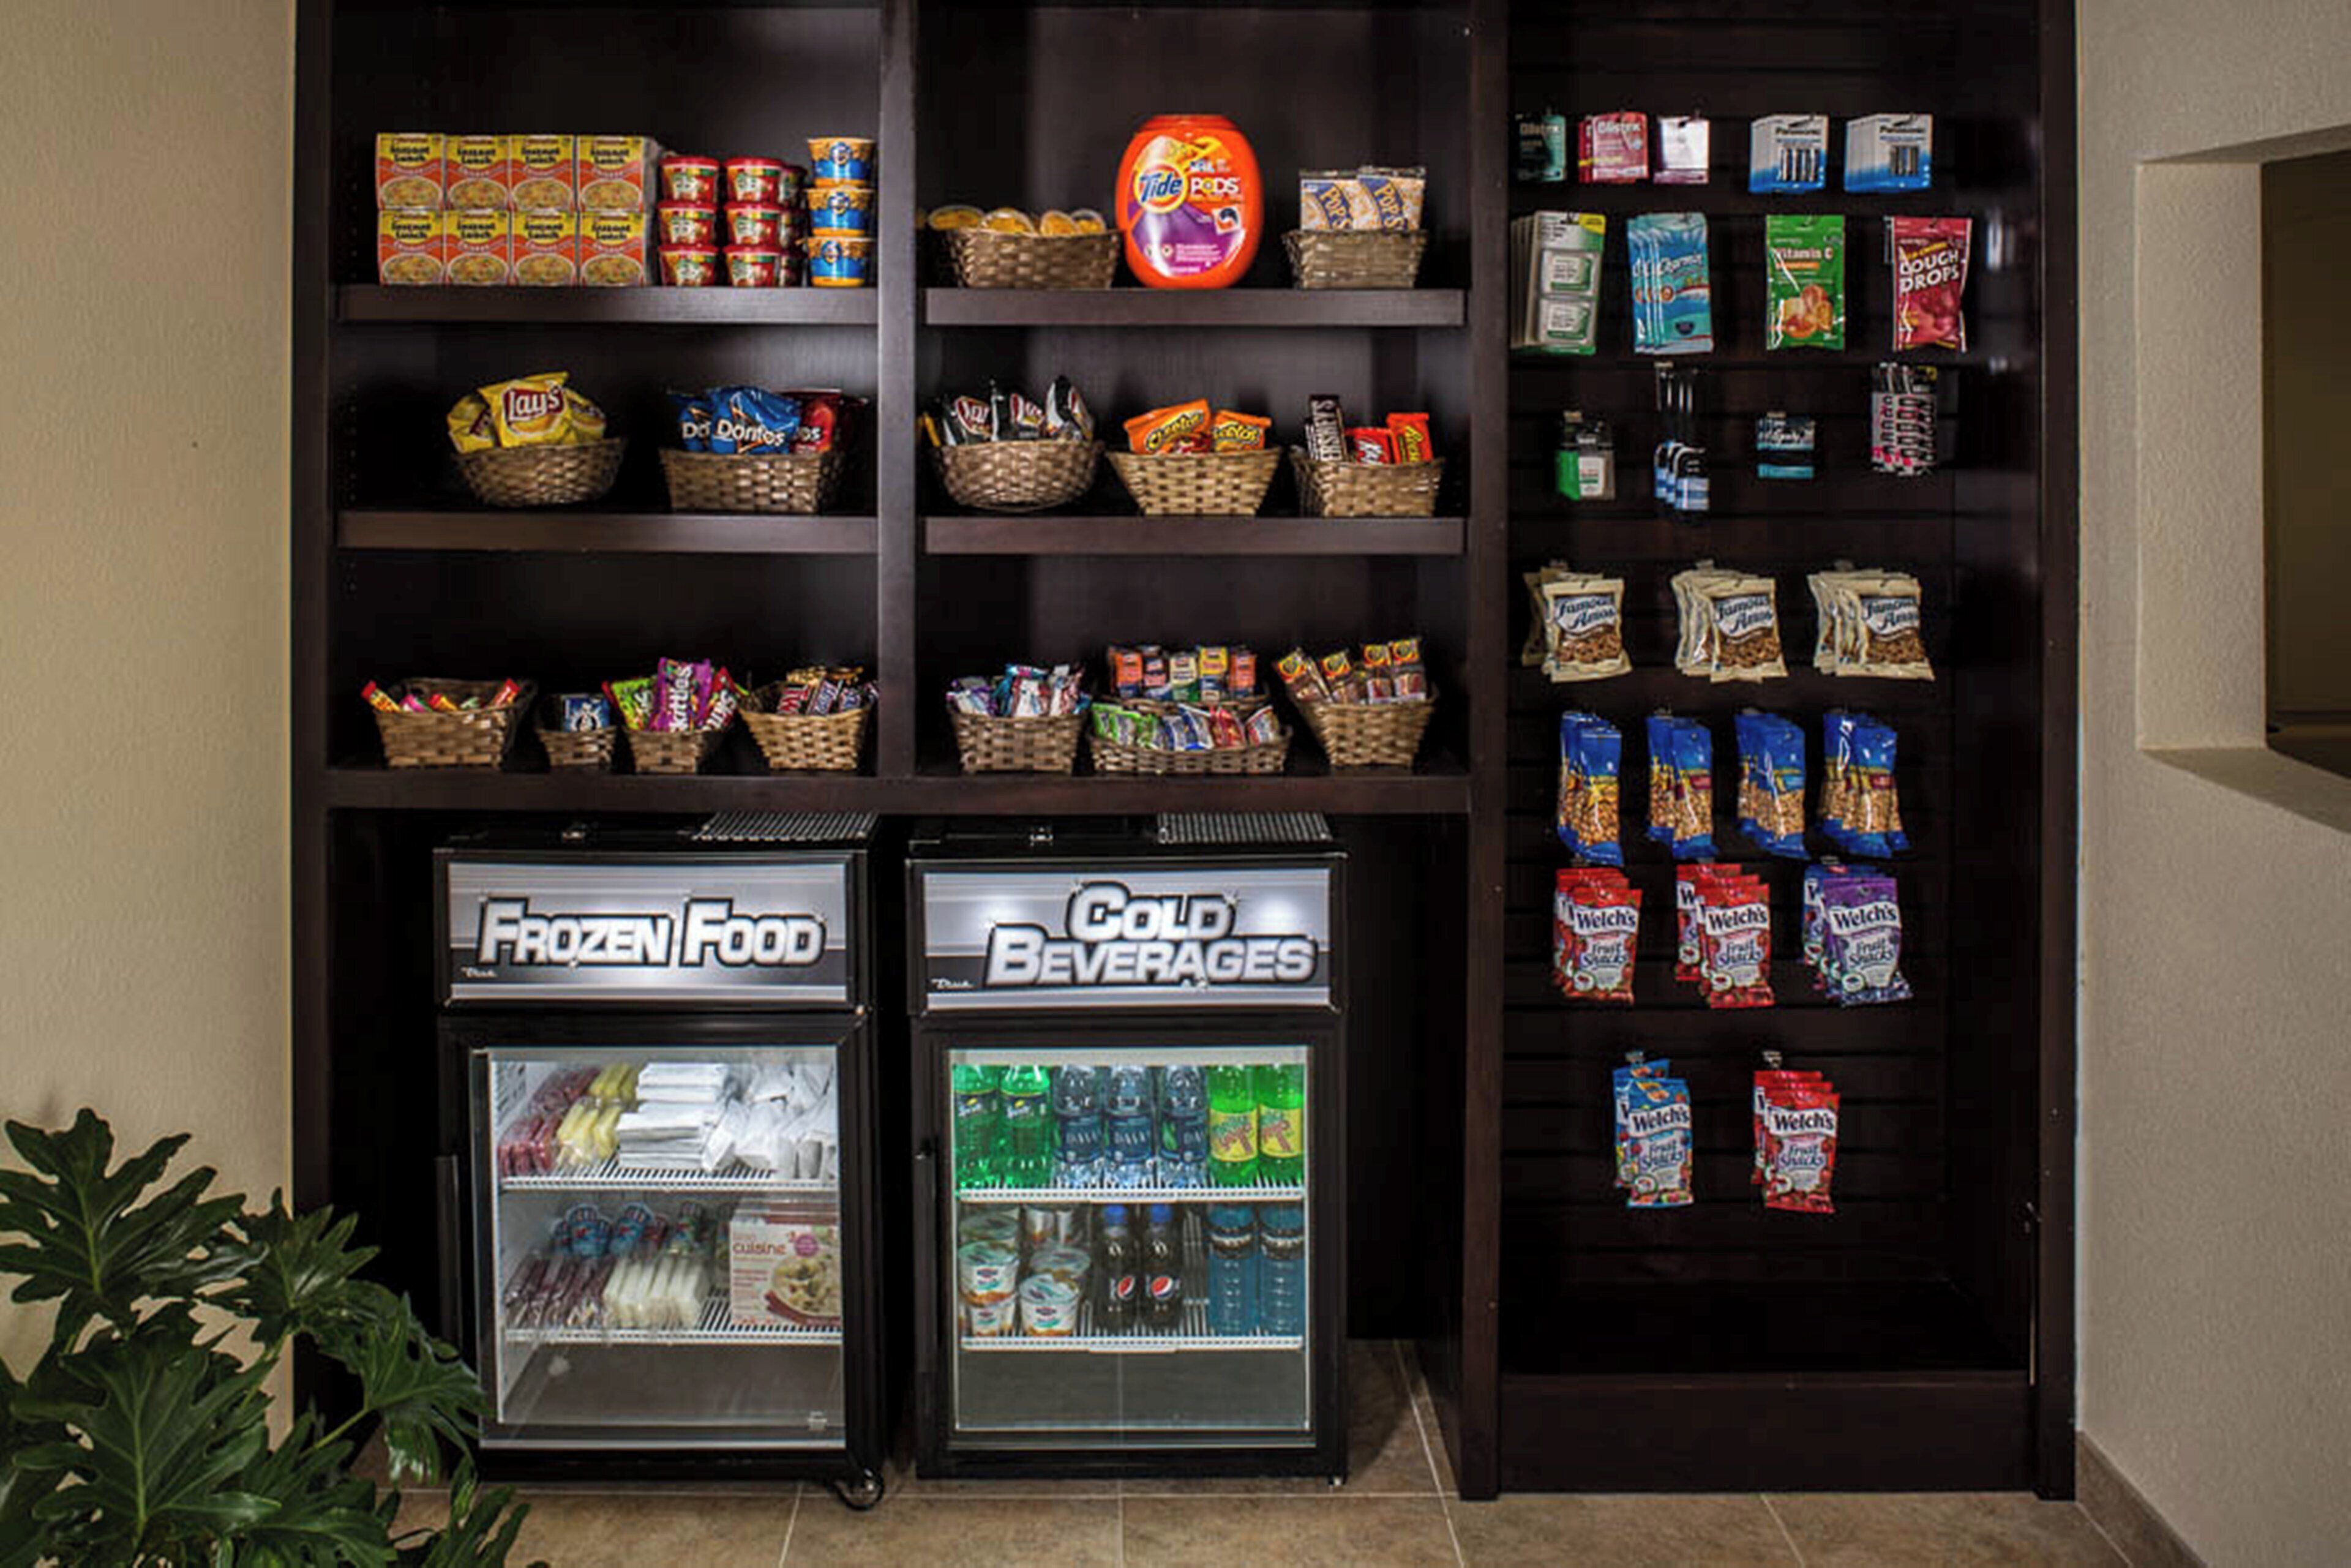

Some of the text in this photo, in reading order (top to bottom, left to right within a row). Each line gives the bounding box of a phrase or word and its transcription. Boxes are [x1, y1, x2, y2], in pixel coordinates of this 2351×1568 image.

[1139, 174, 1182, 204] Tide
[1191, 177, 1240, 193] PODS
[1900, 250, 1958, 274] COUGH
[1900, 266, 1959, 293] DROPS
[508, 389, 560, 421] Lay's
[716, 419, 786, 446] Doritos
[1070, 882, 1233, 941] COLD
[1577, 909, 1636, 928] Welch's
[1709, 908, 1768, 929] Welch's
[1834, 904, 1897, 929] Welch's
[478, 899, 824, 966] FROZEN FOOD
[987, 925, 1315, 984] BEVERAGES
[1633, 1103, 1690, 1131] Welch's
[1775, 1110, 1834, 1130] Welch's
[733, 1242, 786, 1255] cuisine
